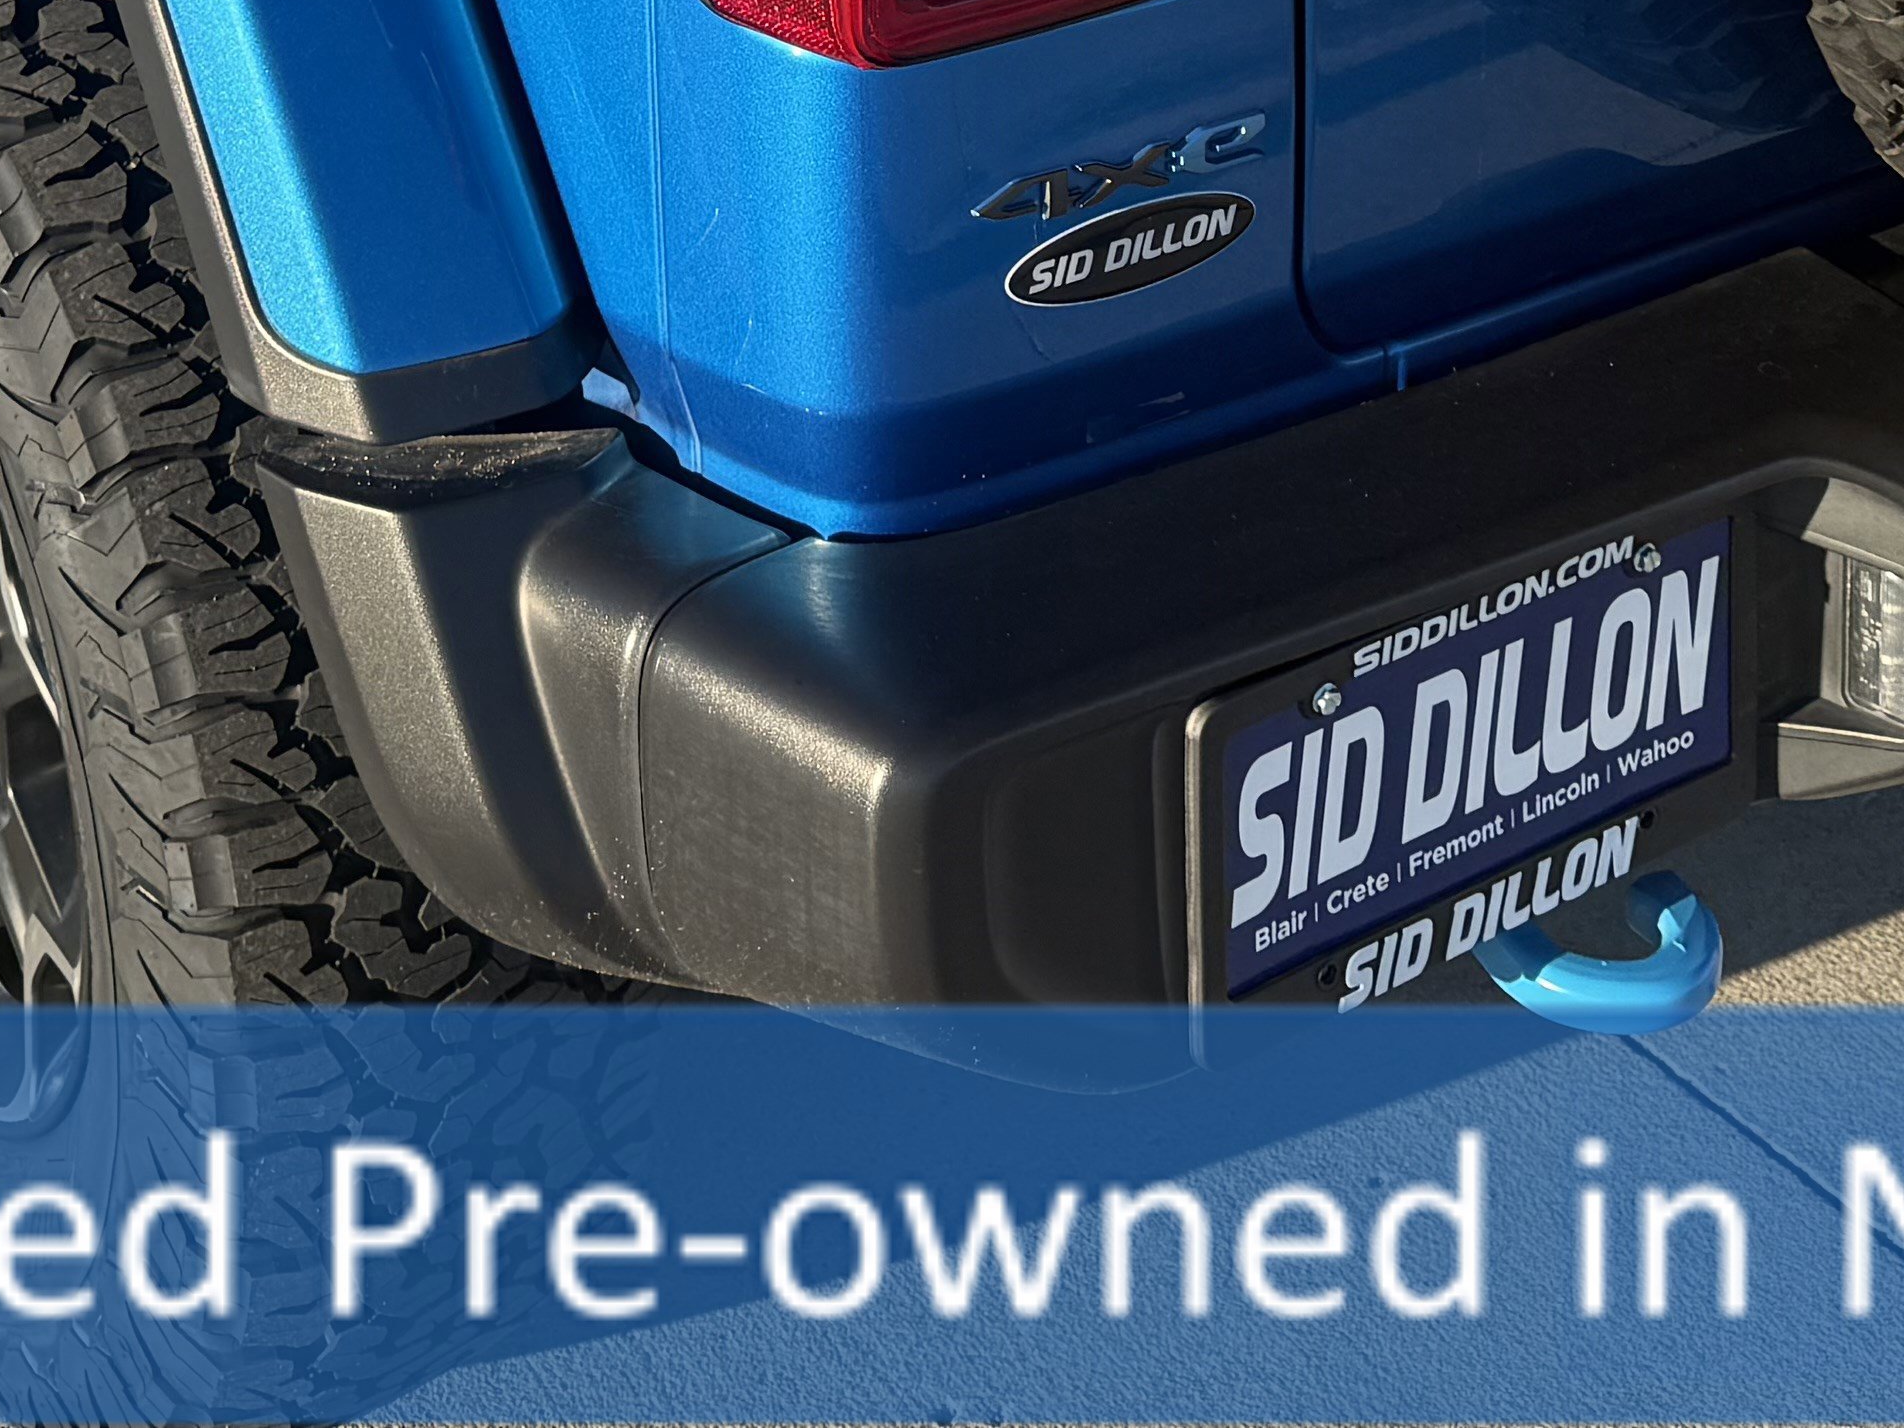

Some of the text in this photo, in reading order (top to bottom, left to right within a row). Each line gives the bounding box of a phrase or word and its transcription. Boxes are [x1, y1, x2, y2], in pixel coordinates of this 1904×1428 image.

[1028, 204, 1238, 296] SID DILLON
[1352, 535, 1635, 678] SIDDILLON.COM
[1230, 554, 1721, 930] SID DILLON
[1253, 729, 1695, 953] Blair Crete Fremont Lincoln Wahoo
[1337, 816, 1640, 1014] SID DILLON
